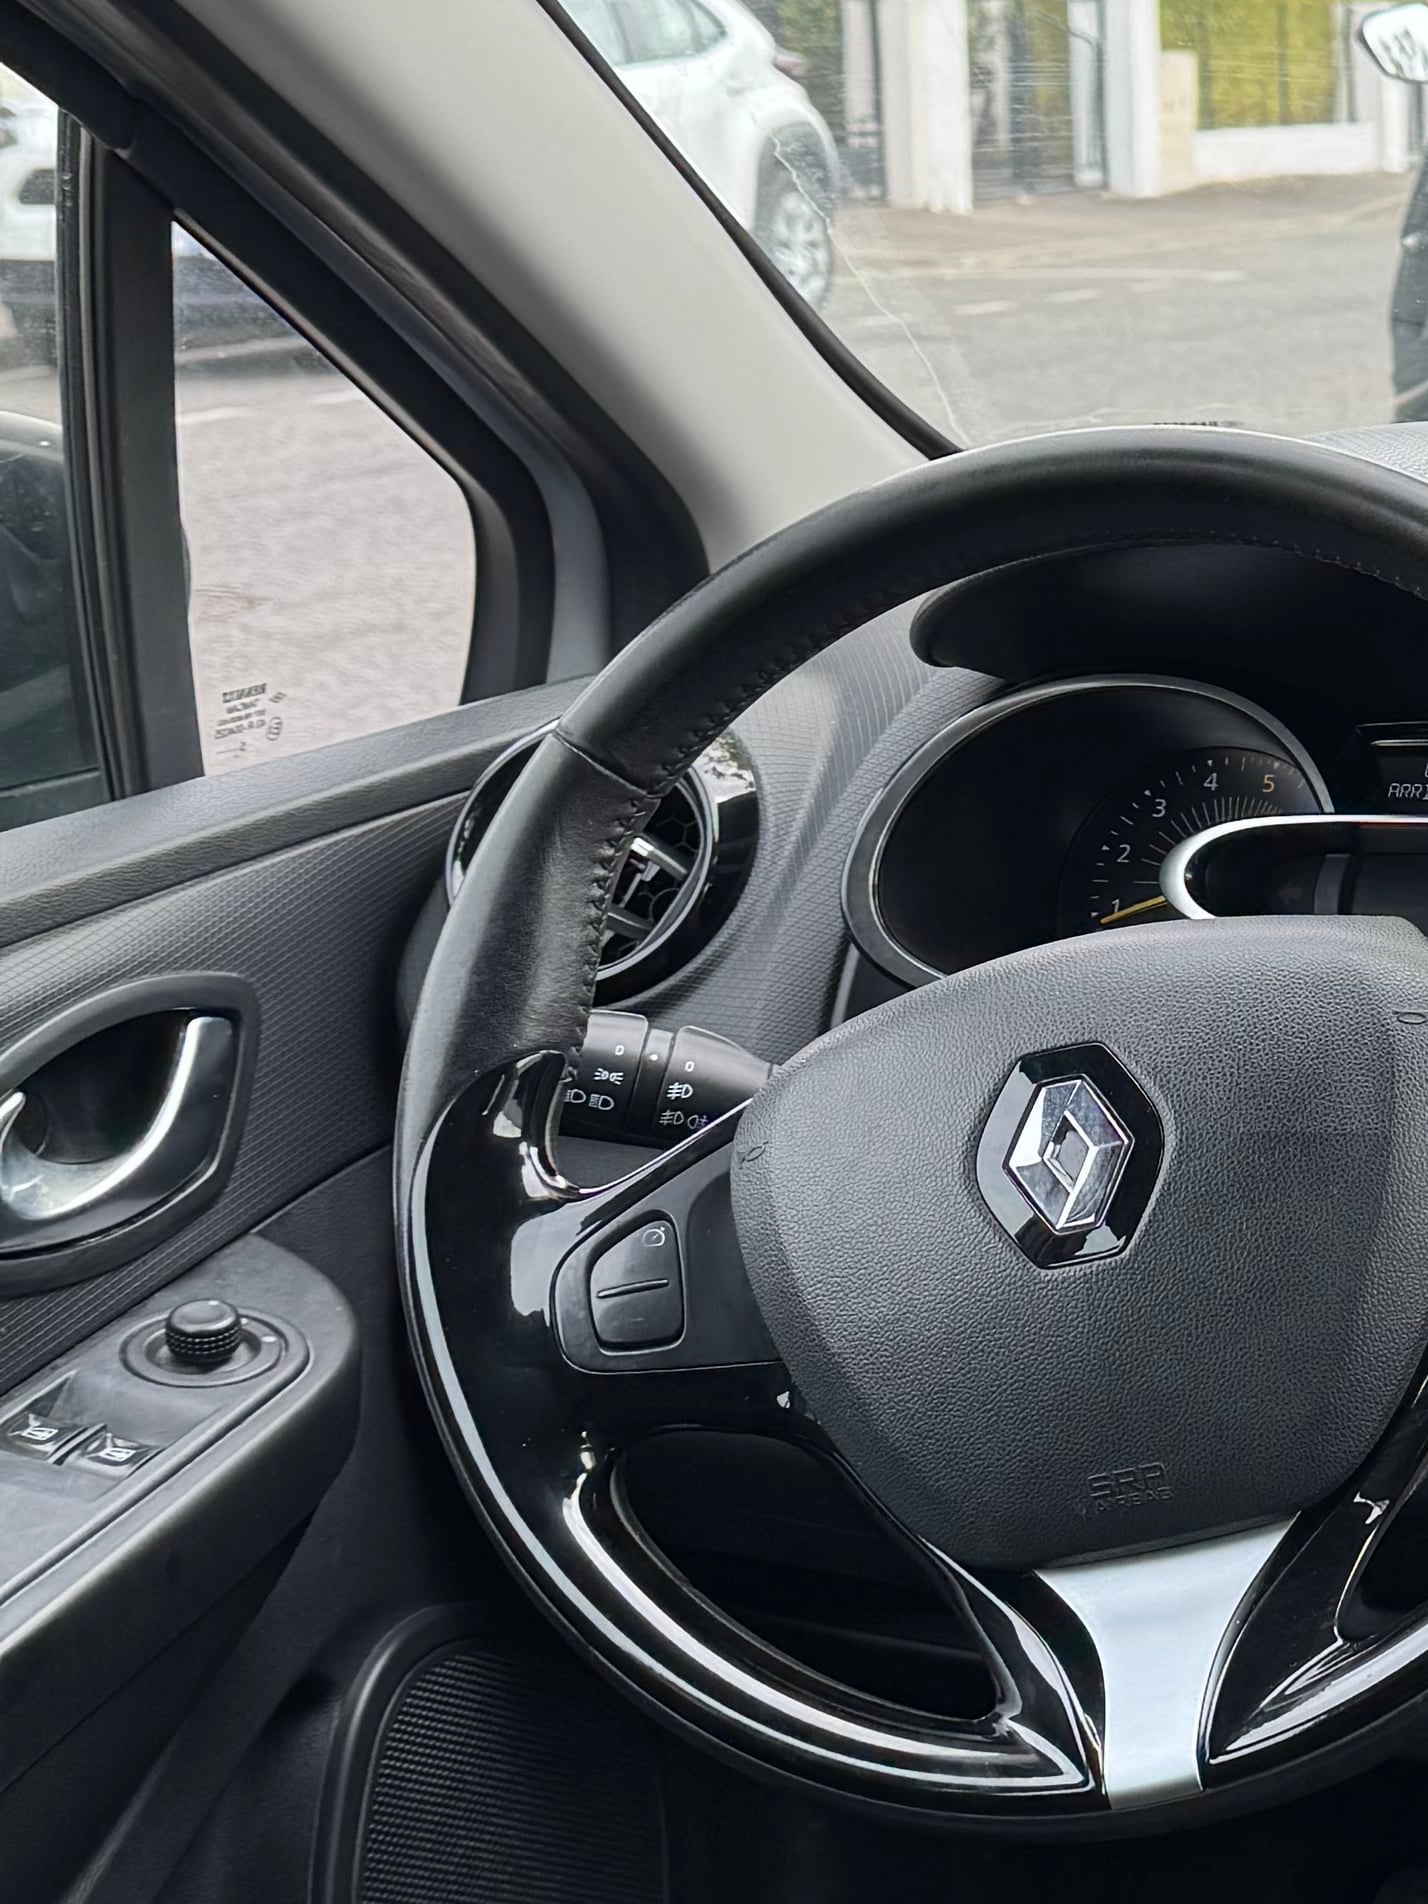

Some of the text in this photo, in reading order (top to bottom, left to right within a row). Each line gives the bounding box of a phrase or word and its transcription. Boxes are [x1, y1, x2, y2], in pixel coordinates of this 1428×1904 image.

[1203, 773, 1219, 791] 4
[1262, 775, 1275, 793] 5
[1152, 799, 1167, 817] 3
[1117, 844, 1131, 862] 2
[1111, 899, 1120, 914] 1
